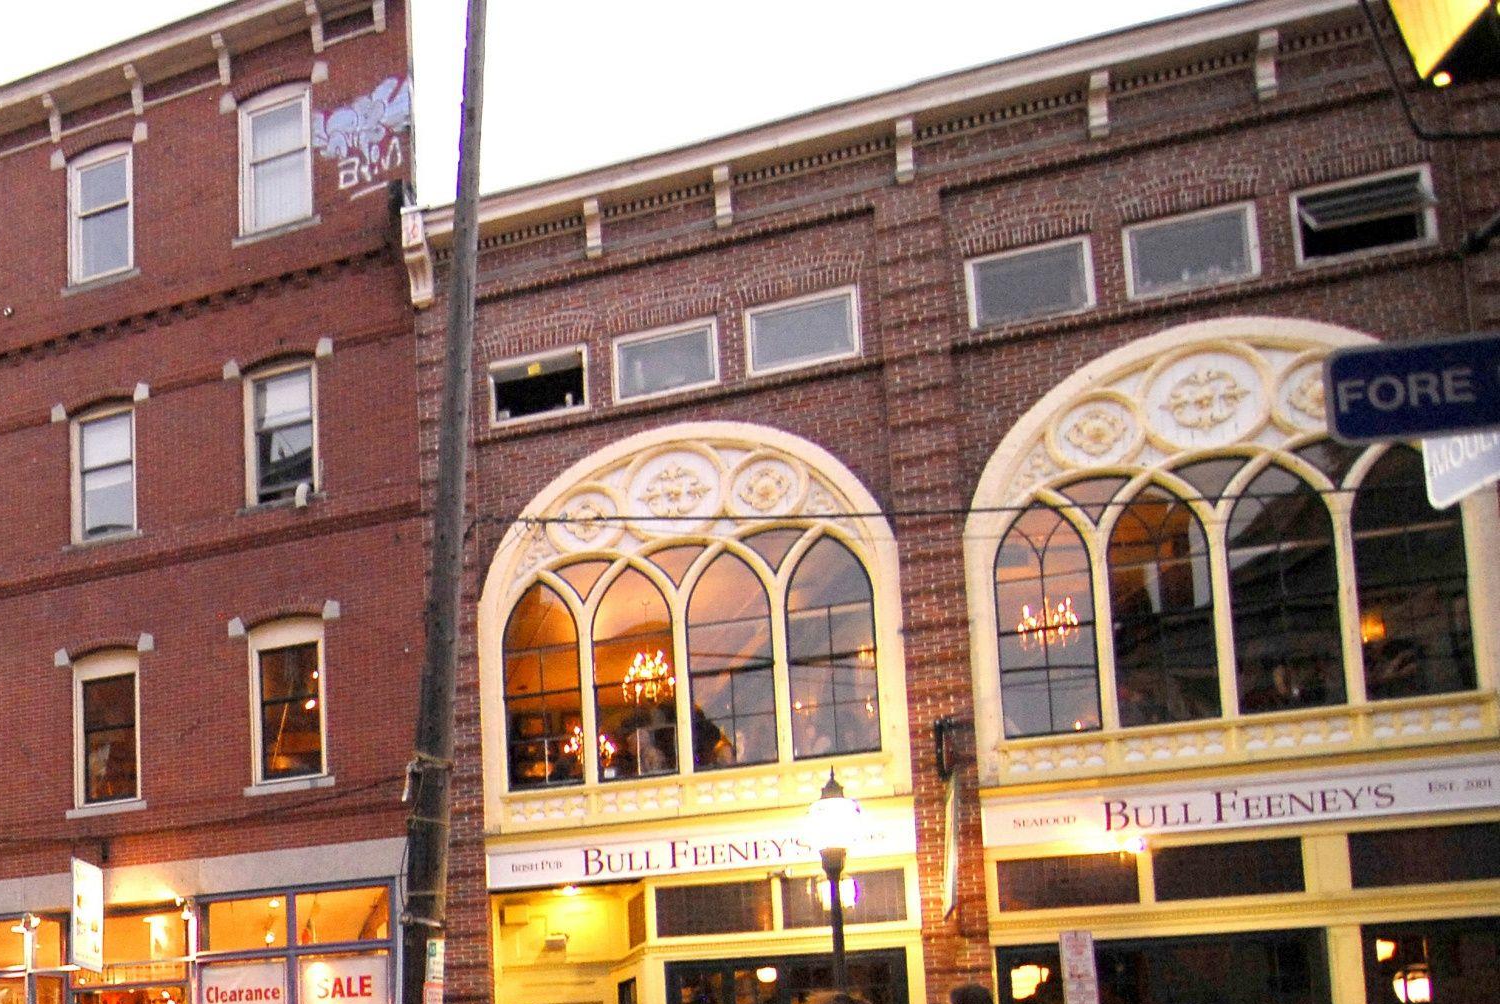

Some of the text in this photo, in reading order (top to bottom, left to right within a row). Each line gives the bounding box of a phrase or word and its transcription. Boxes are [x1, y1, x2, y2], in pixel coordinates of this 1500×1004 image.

[1336, 365, 1476, 415] FORE
[1013, 815, 1077, 829] SEAFOOD
[1104, 800, 1201, 832] BULL
[1214, 783, 1396, 823] FEENEY'S
[540, 860, 563, 870] PUB
[582, 848, 660, 876] BULL
[670, 837, 812, 869] FEENEY'S
[206, 986, 281, 1004] Clearance
[317, 975, 373, 1000] SALE
